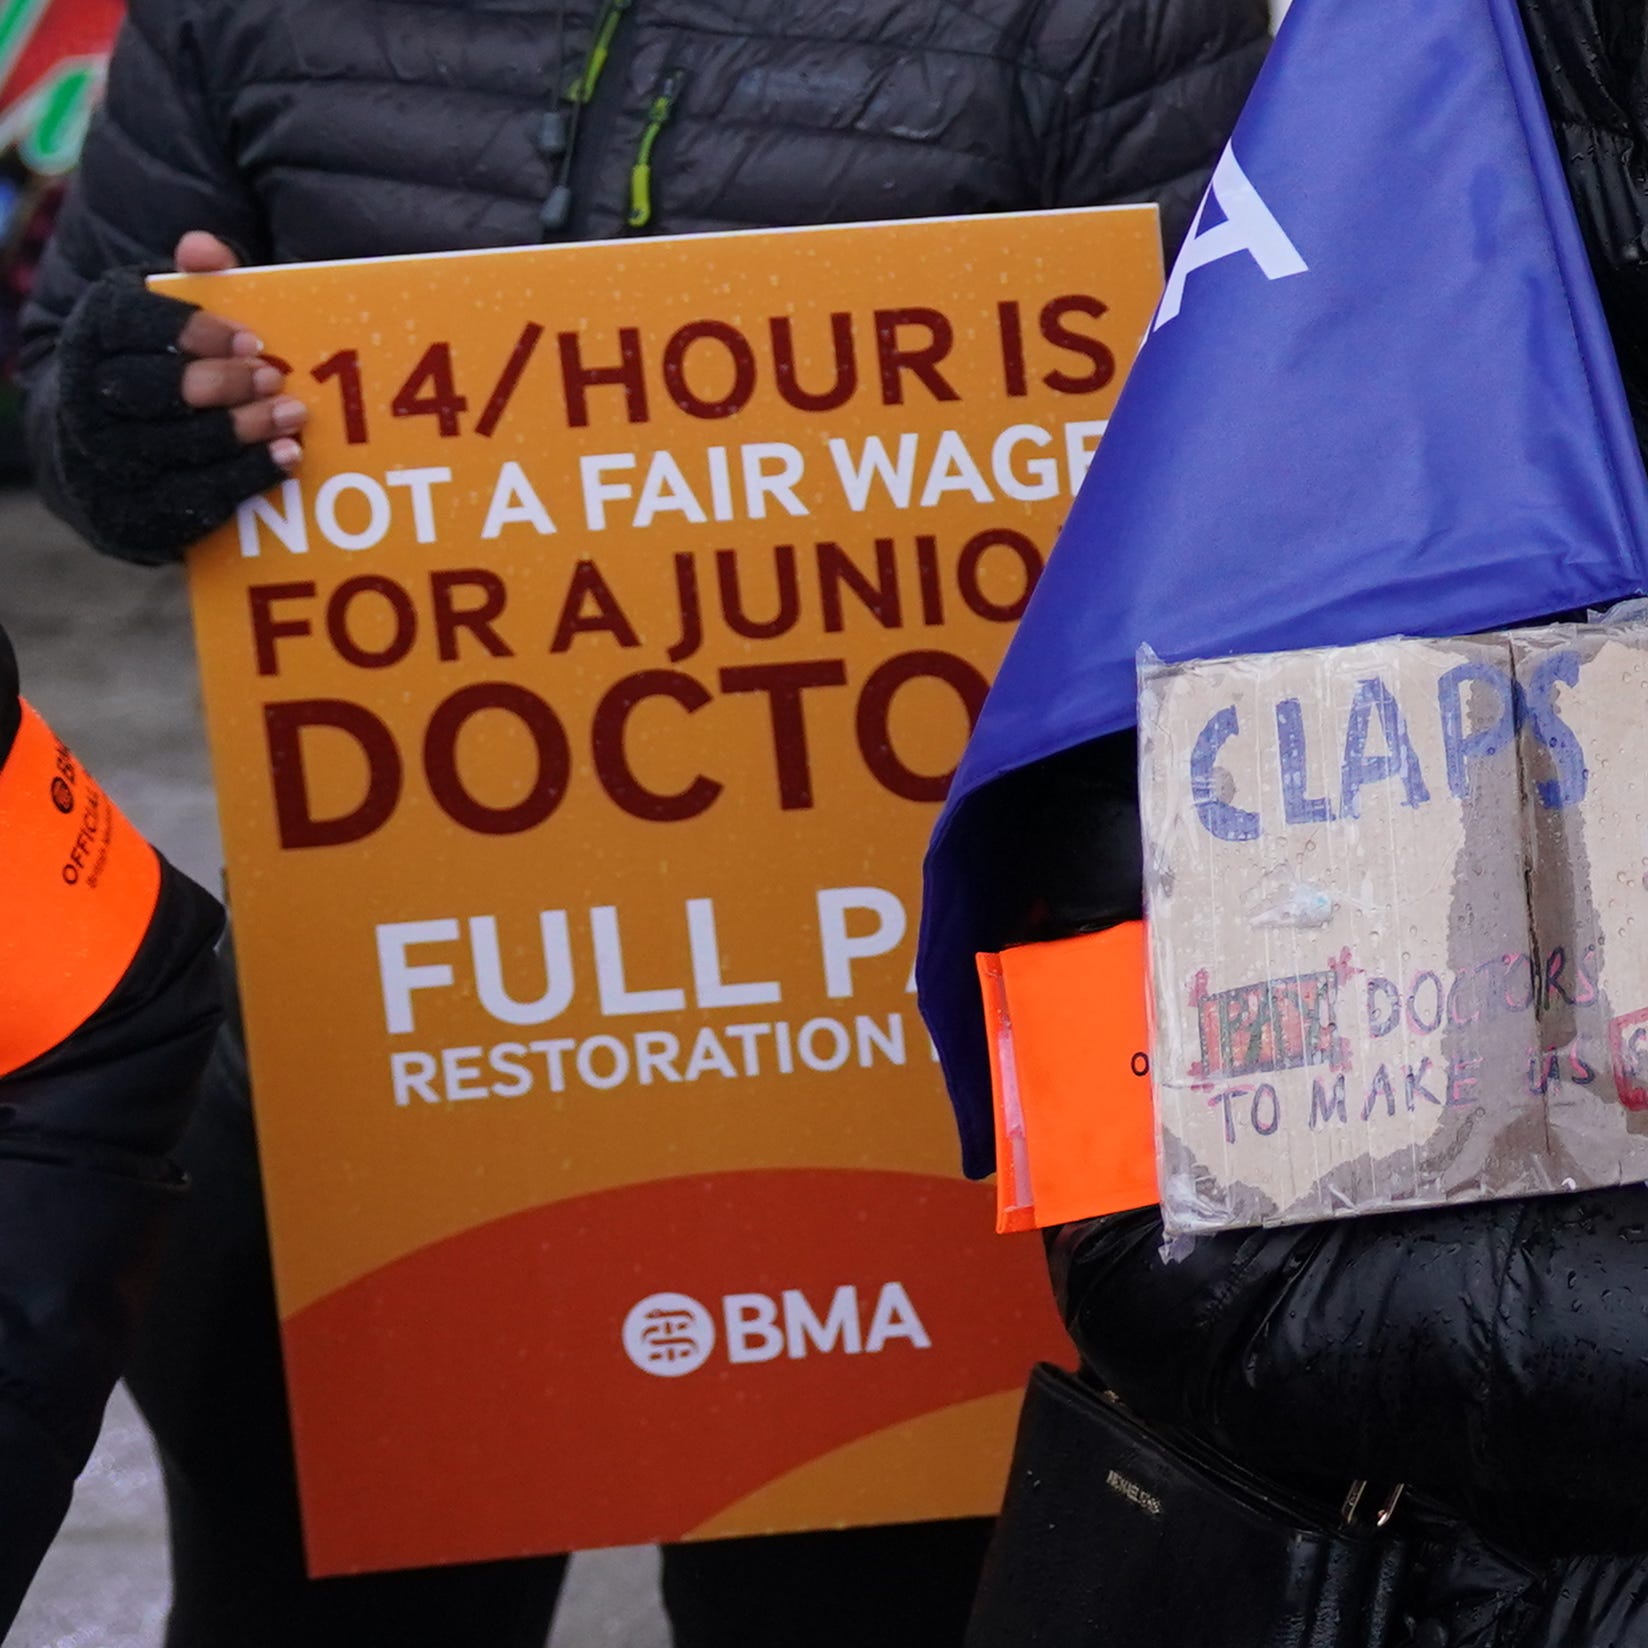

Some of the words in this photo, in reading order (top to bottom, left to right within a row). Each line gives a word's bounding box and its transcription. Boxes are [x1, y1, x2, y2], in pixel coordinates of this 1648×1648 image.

[258, 302, 962, 452] 14/HOUR
[998, 294, 1118, 397] IS
[237, 465, 453, 558] NOT
[480, 460, 558, 540] A
[580, 441, 810, 532] FAIR
[247, 568, 512, 677] FOR
[548, 558, 643, 654] A
[664, 522, 1068, 664] JUNIO
[263, 649, 994, 852] DOCTO
[1189, 655, 1588, 842] CLAPS
[374, 897, 782, 1035] FULL
[1366, 947, 1601, 1040] DOCTORS
[390, 1012, 908, 1108] RESTORATION
[1207, 1083, 1281, 1144] TO
[1308, 1055, 1486, 1130] MAKE
[722, 1282, 932, 1365] BMA
